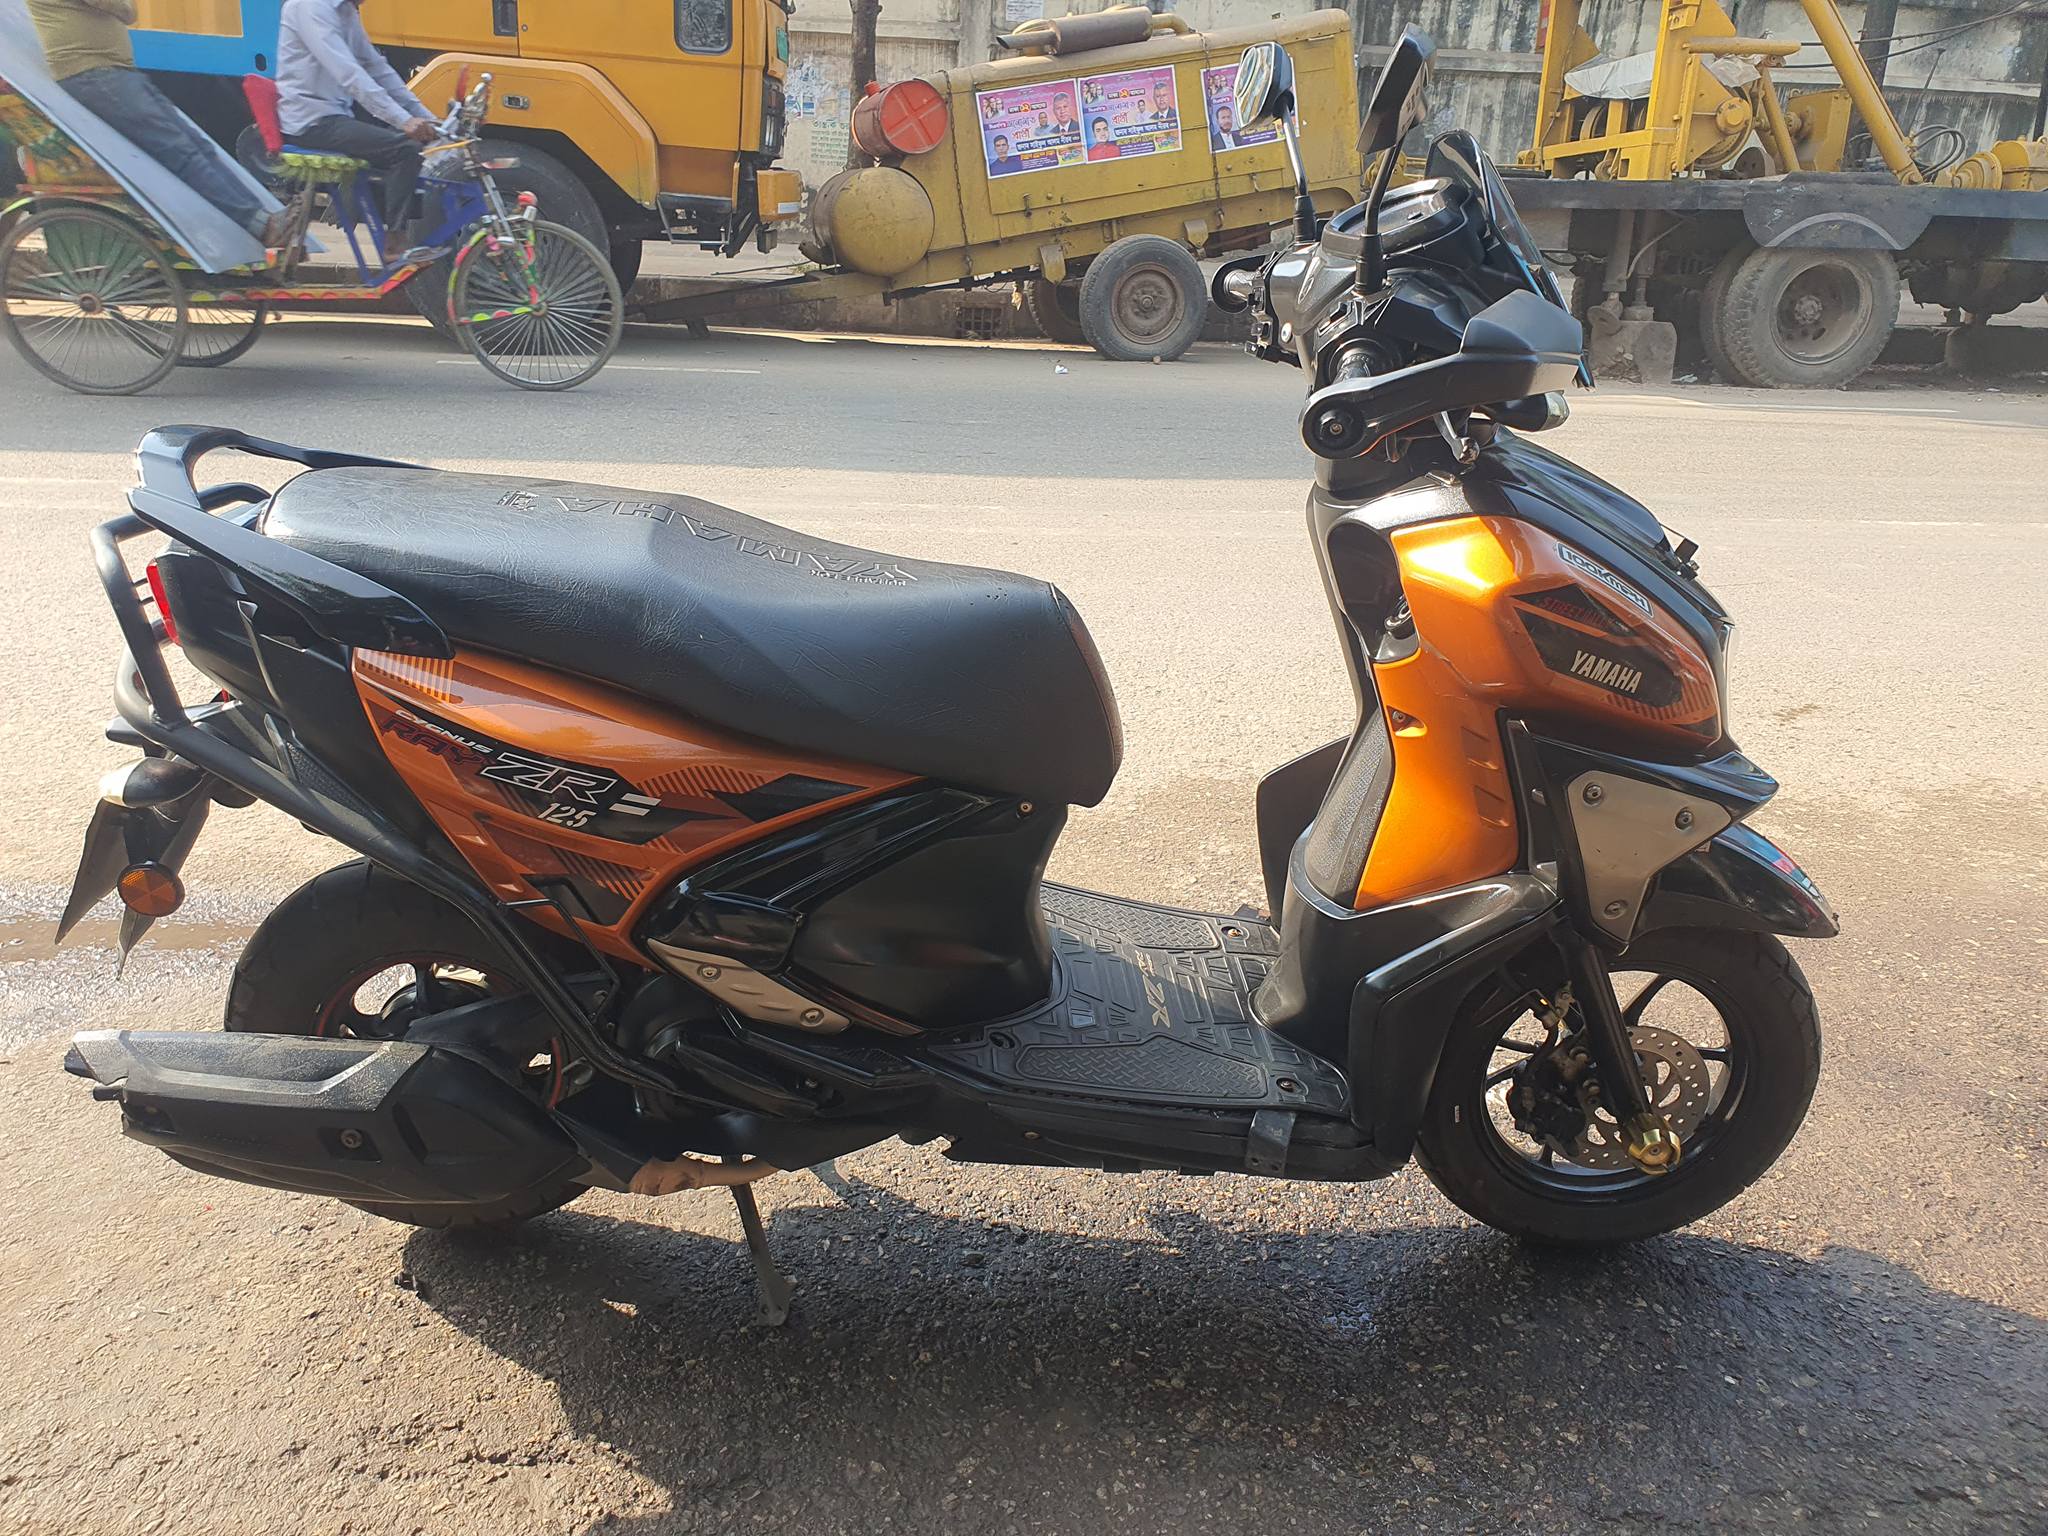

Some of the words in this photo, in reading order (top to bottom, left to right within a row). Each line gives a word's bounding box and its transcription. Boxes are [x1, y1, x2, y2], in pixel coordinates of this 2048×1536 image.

[554, 497, 918, 581] YAMAHA
[1570, 650, 1643, 694] YAMAHA
[395, 709, 494, 754] CYGNUS
[480, 752, 618, 804] ZR
[538, 802, 597, 828] 125
[1142, 974, 1171, 1029] ZR
